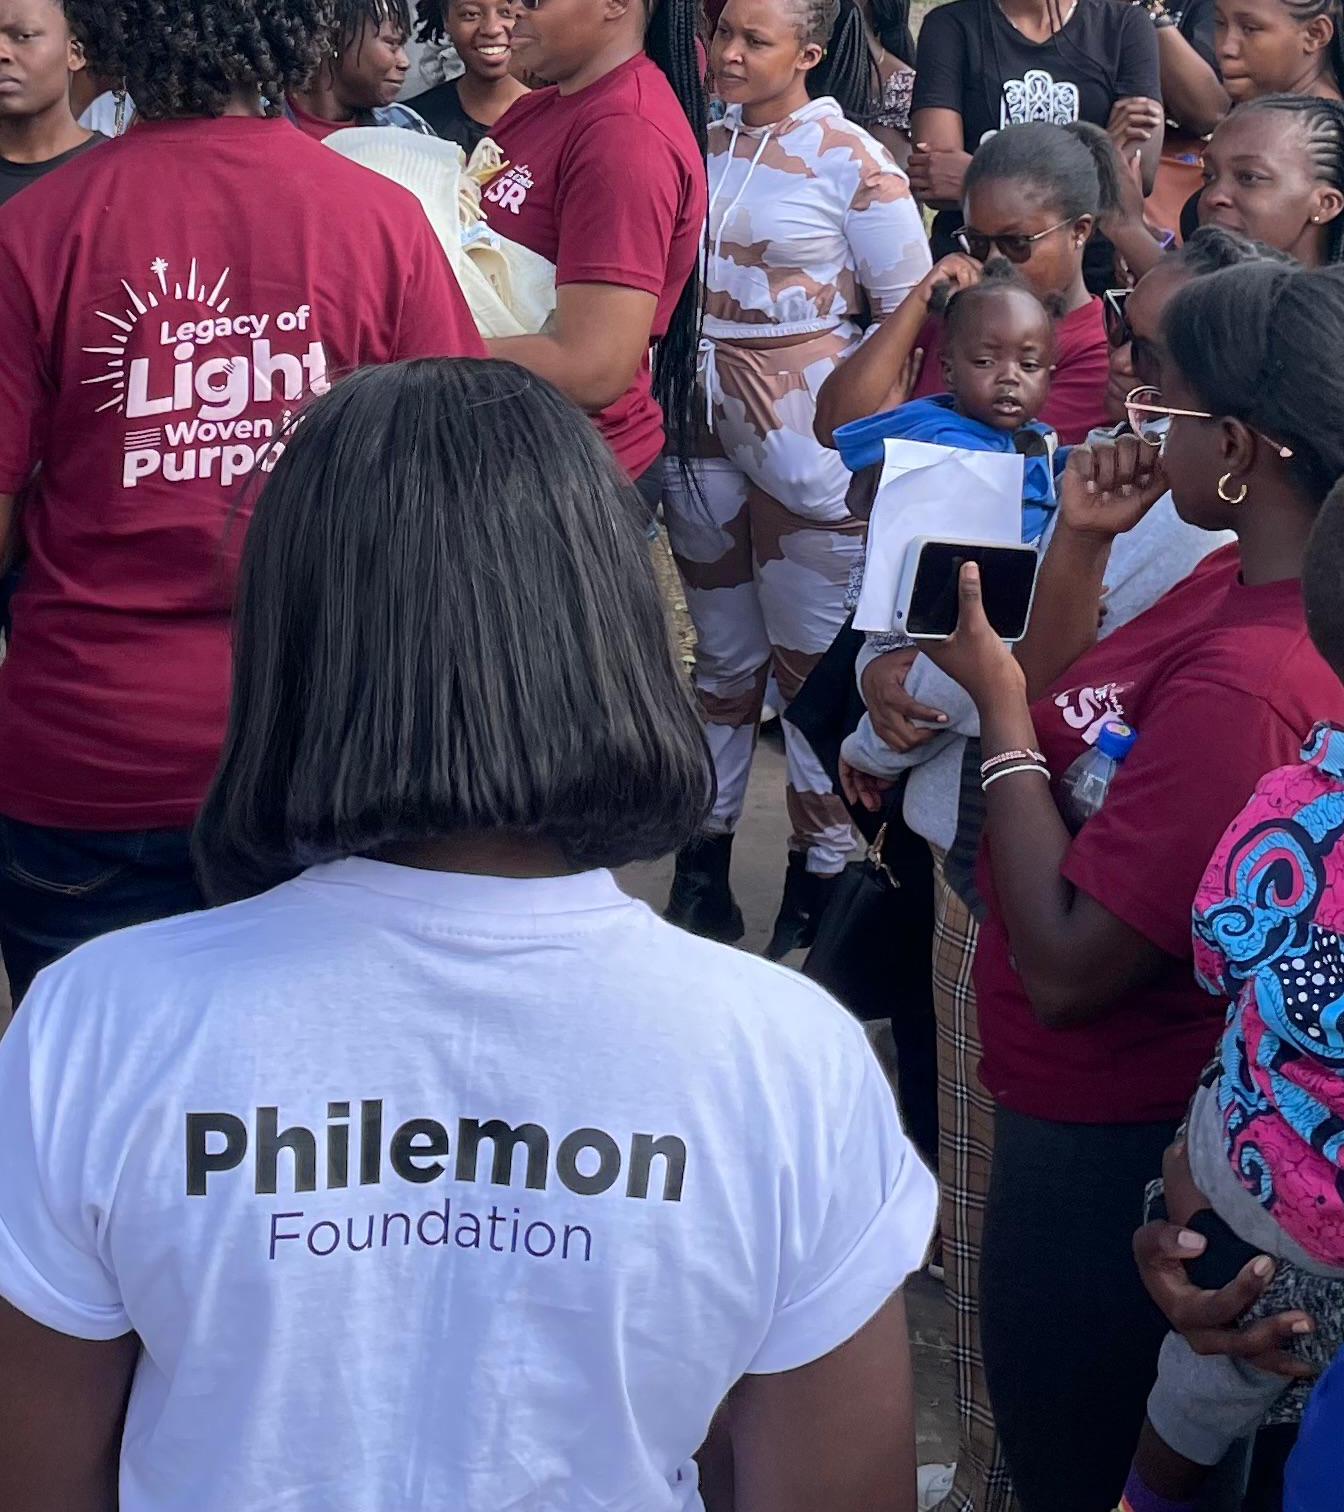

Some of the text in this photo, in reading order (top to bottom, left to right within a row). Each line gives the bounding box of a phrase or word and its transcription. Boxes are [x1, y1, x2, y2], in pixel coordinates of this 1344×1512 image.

[484, 176, 527, 215] SR
[160, 305, 311, 346] Legacy of
[125, 339, 332, 422] Light
[164, 417, 273, 448] Woven
[122, 442, 286, 489] Purpo
[185, 1098, 688, 1202] Philemon
[268, 1197, 593, 1262] Foundation
